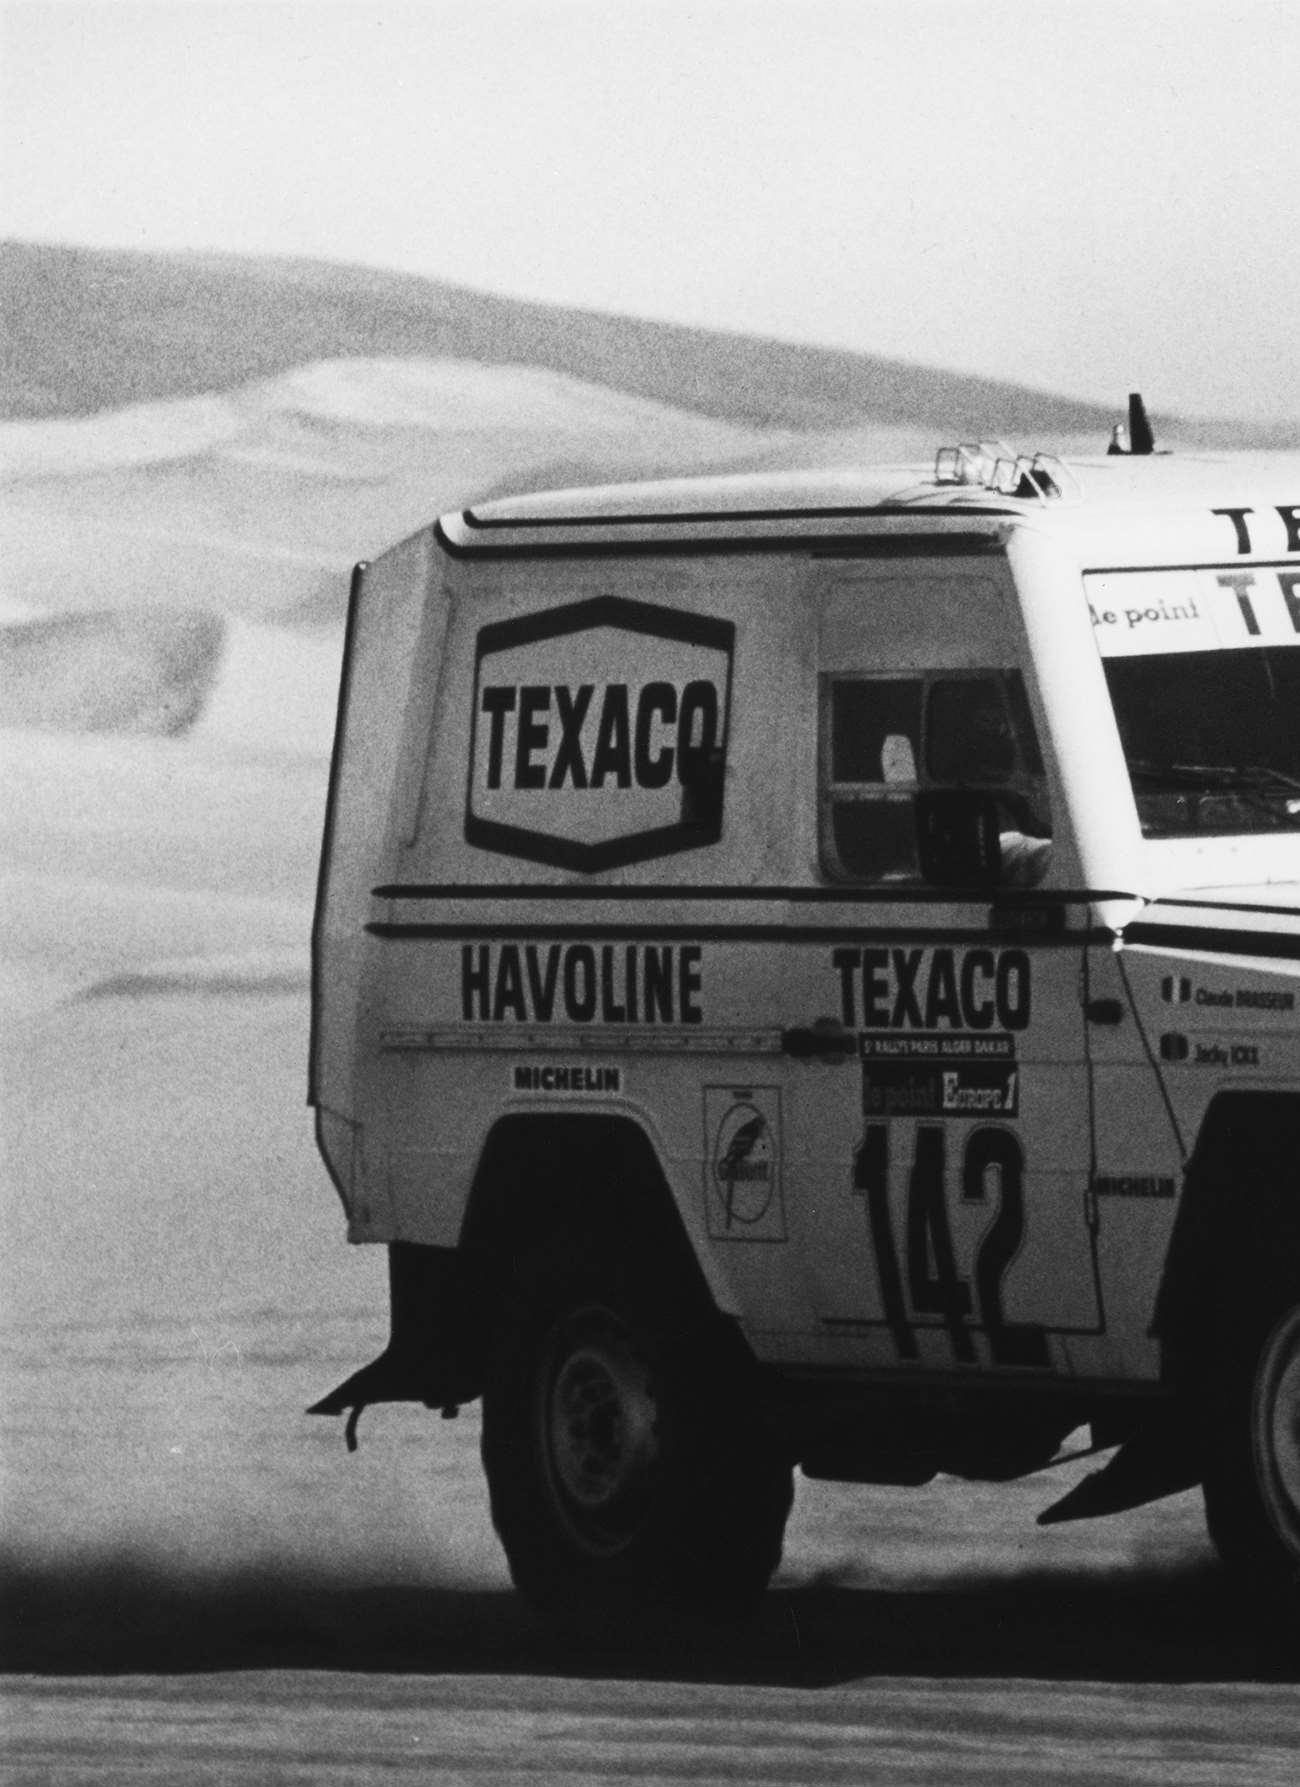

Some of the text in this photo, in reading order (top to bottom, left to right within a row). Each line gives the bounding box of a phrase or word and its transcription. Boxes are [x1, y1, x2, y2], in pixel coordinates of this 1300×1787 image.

[481, 678, 719, 790] TEXACO
[462, 944, 702, 1023] HAVOLINE
[832, 948, 1031, 1030] TEXACO
[514, 1066, 620, 1091] MICHELIN
[1096, 1177, 1175, 1198] MICHELIN
[853, 1125, 1051, 1367] 142
